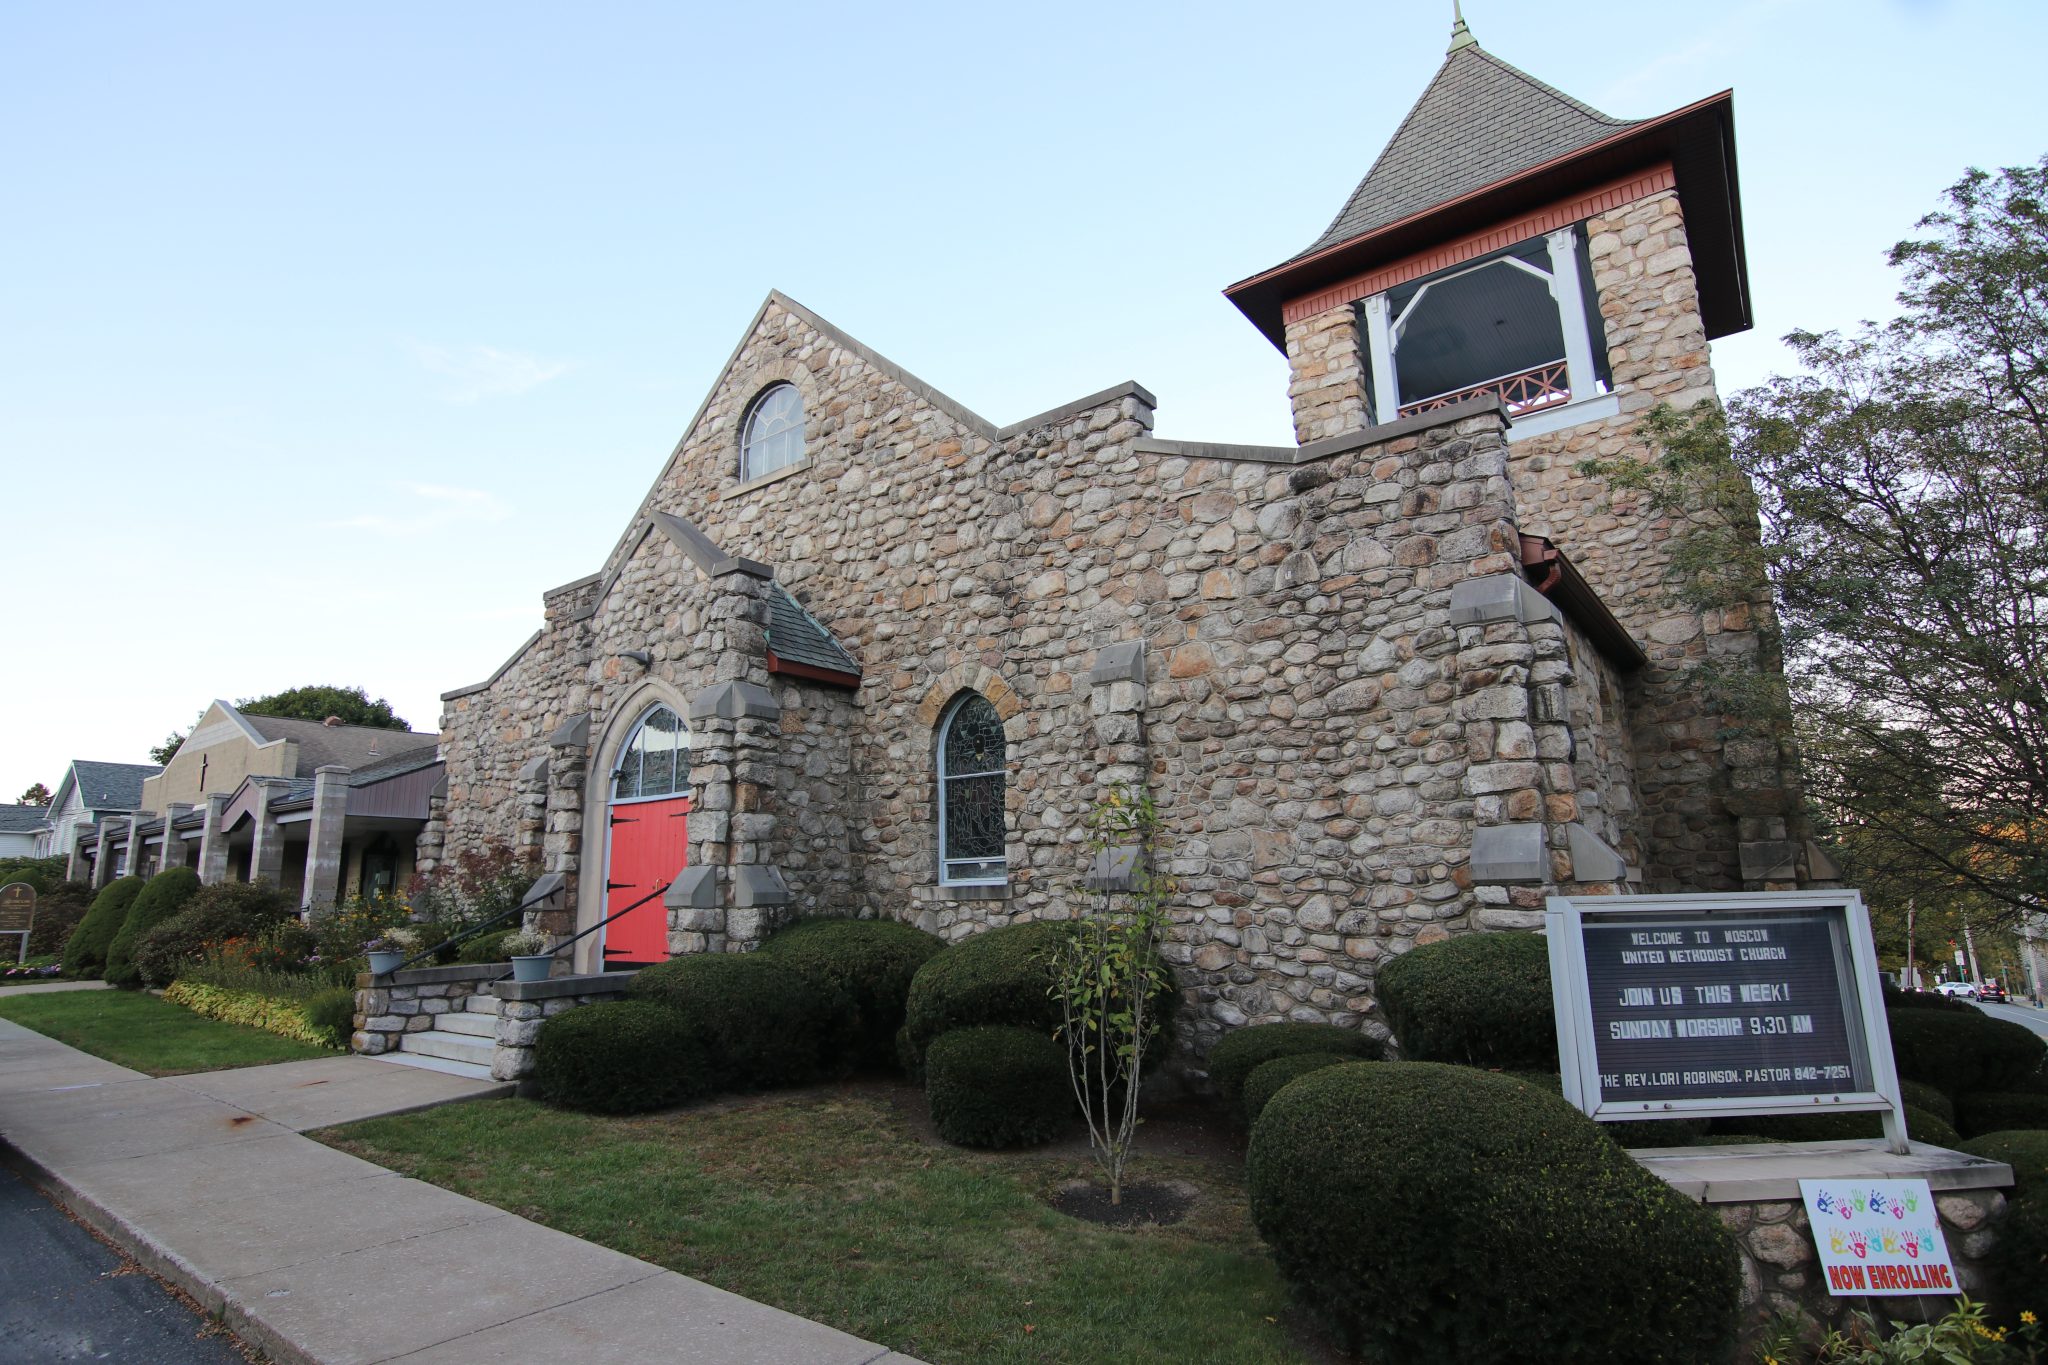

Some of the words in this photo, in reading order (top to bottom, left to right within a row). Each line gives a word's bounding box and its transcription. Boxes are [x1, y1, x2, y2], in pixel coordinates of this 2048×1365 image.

[1631, 932, 1683, 945] WELCOME
[1695, 931, 1710, 943] TO
[1725, 929, 1769, 943] MOSCOW
[1622, 951, 1665, 964] UNITED
[1669, 949, 1734, 963] METHODIST
[1740, 947, 1787, 961] CHURCH
[1619, 987, 1654, 1006] JOIN
[1659, 987, 1682, 1005] US
[1695, 985, 1732, 1003] THIS
[1740, 983, 1790, 1002] WEEK!
[1610, 1020, 1672, 1039] SUNDAY
[1676, 1018, 1743, 1037] WORSHIP
[1791, 1015, 1813, 1033] AM
[1599, 1075, 1620, 1087] THE
[1745, 1068, 1791, 1082] PASTOR
[1794, 1066, 1851, 1080] 842-7251
[1828, 1266, 1866, 1289] NOW
[1866, 1264, 1953, 1289] ENROLLING
